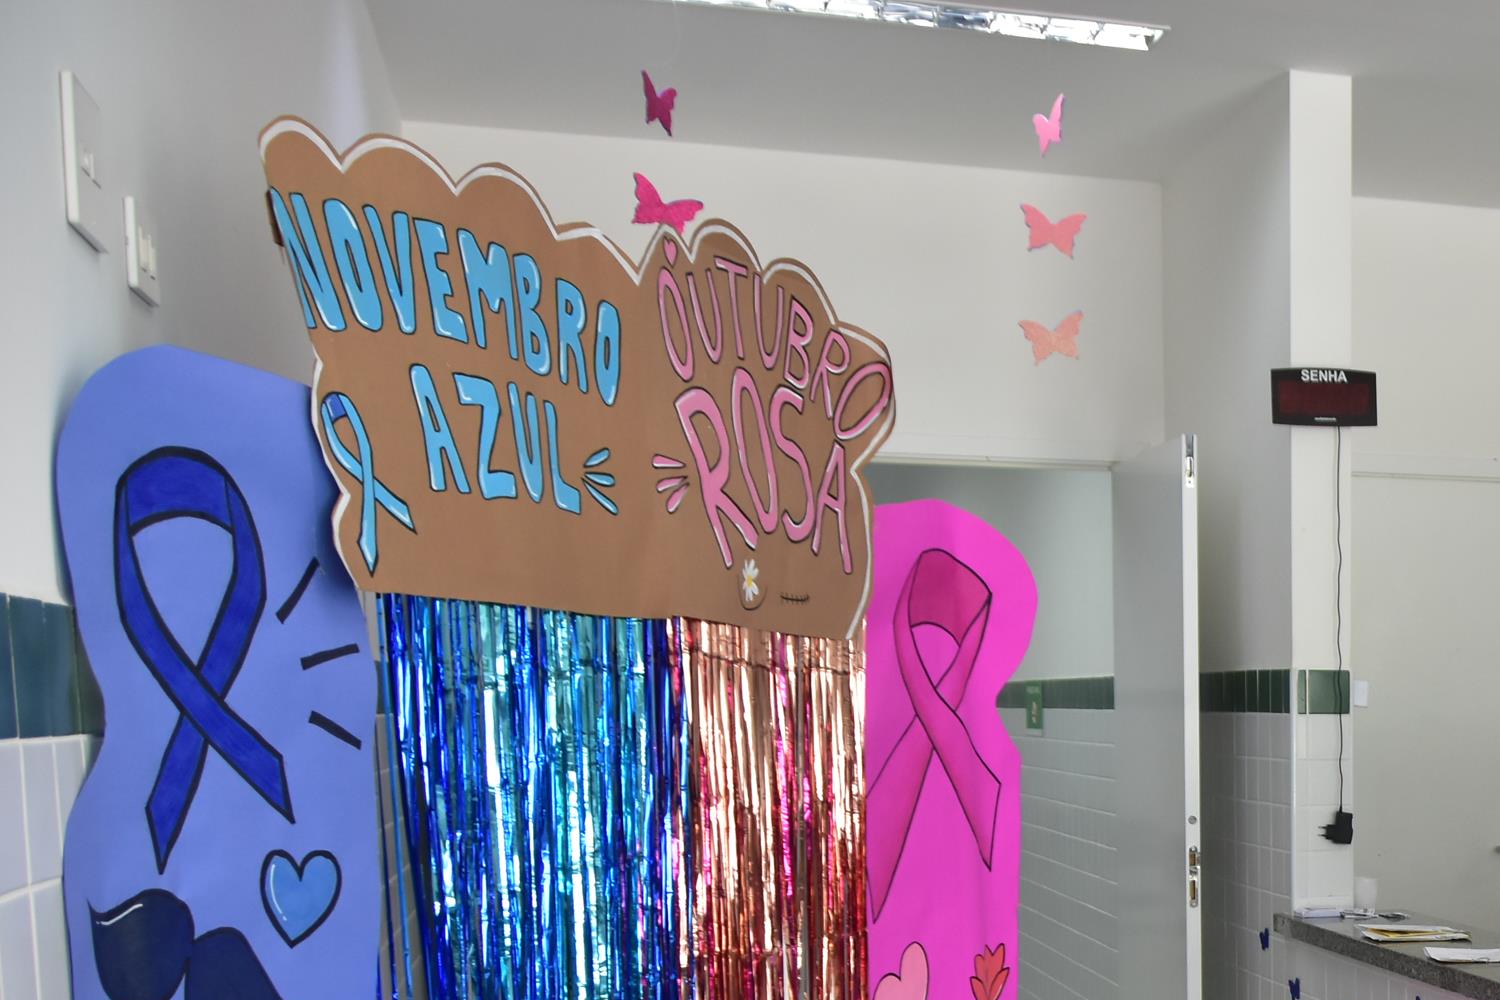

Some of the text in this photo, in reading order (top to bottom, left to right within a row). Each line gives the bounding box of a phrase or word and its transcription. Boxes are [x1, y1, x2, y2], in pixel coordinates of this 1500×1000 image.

[268, 186, 621, 406] NOVEMBRO
[656, 254, 893, 440] OUTUBRO
[1301, 368, 1348, 383] SENHA
[410, 363, 582, 515] AZUL
[673, 367, 853, 574] ROSA
